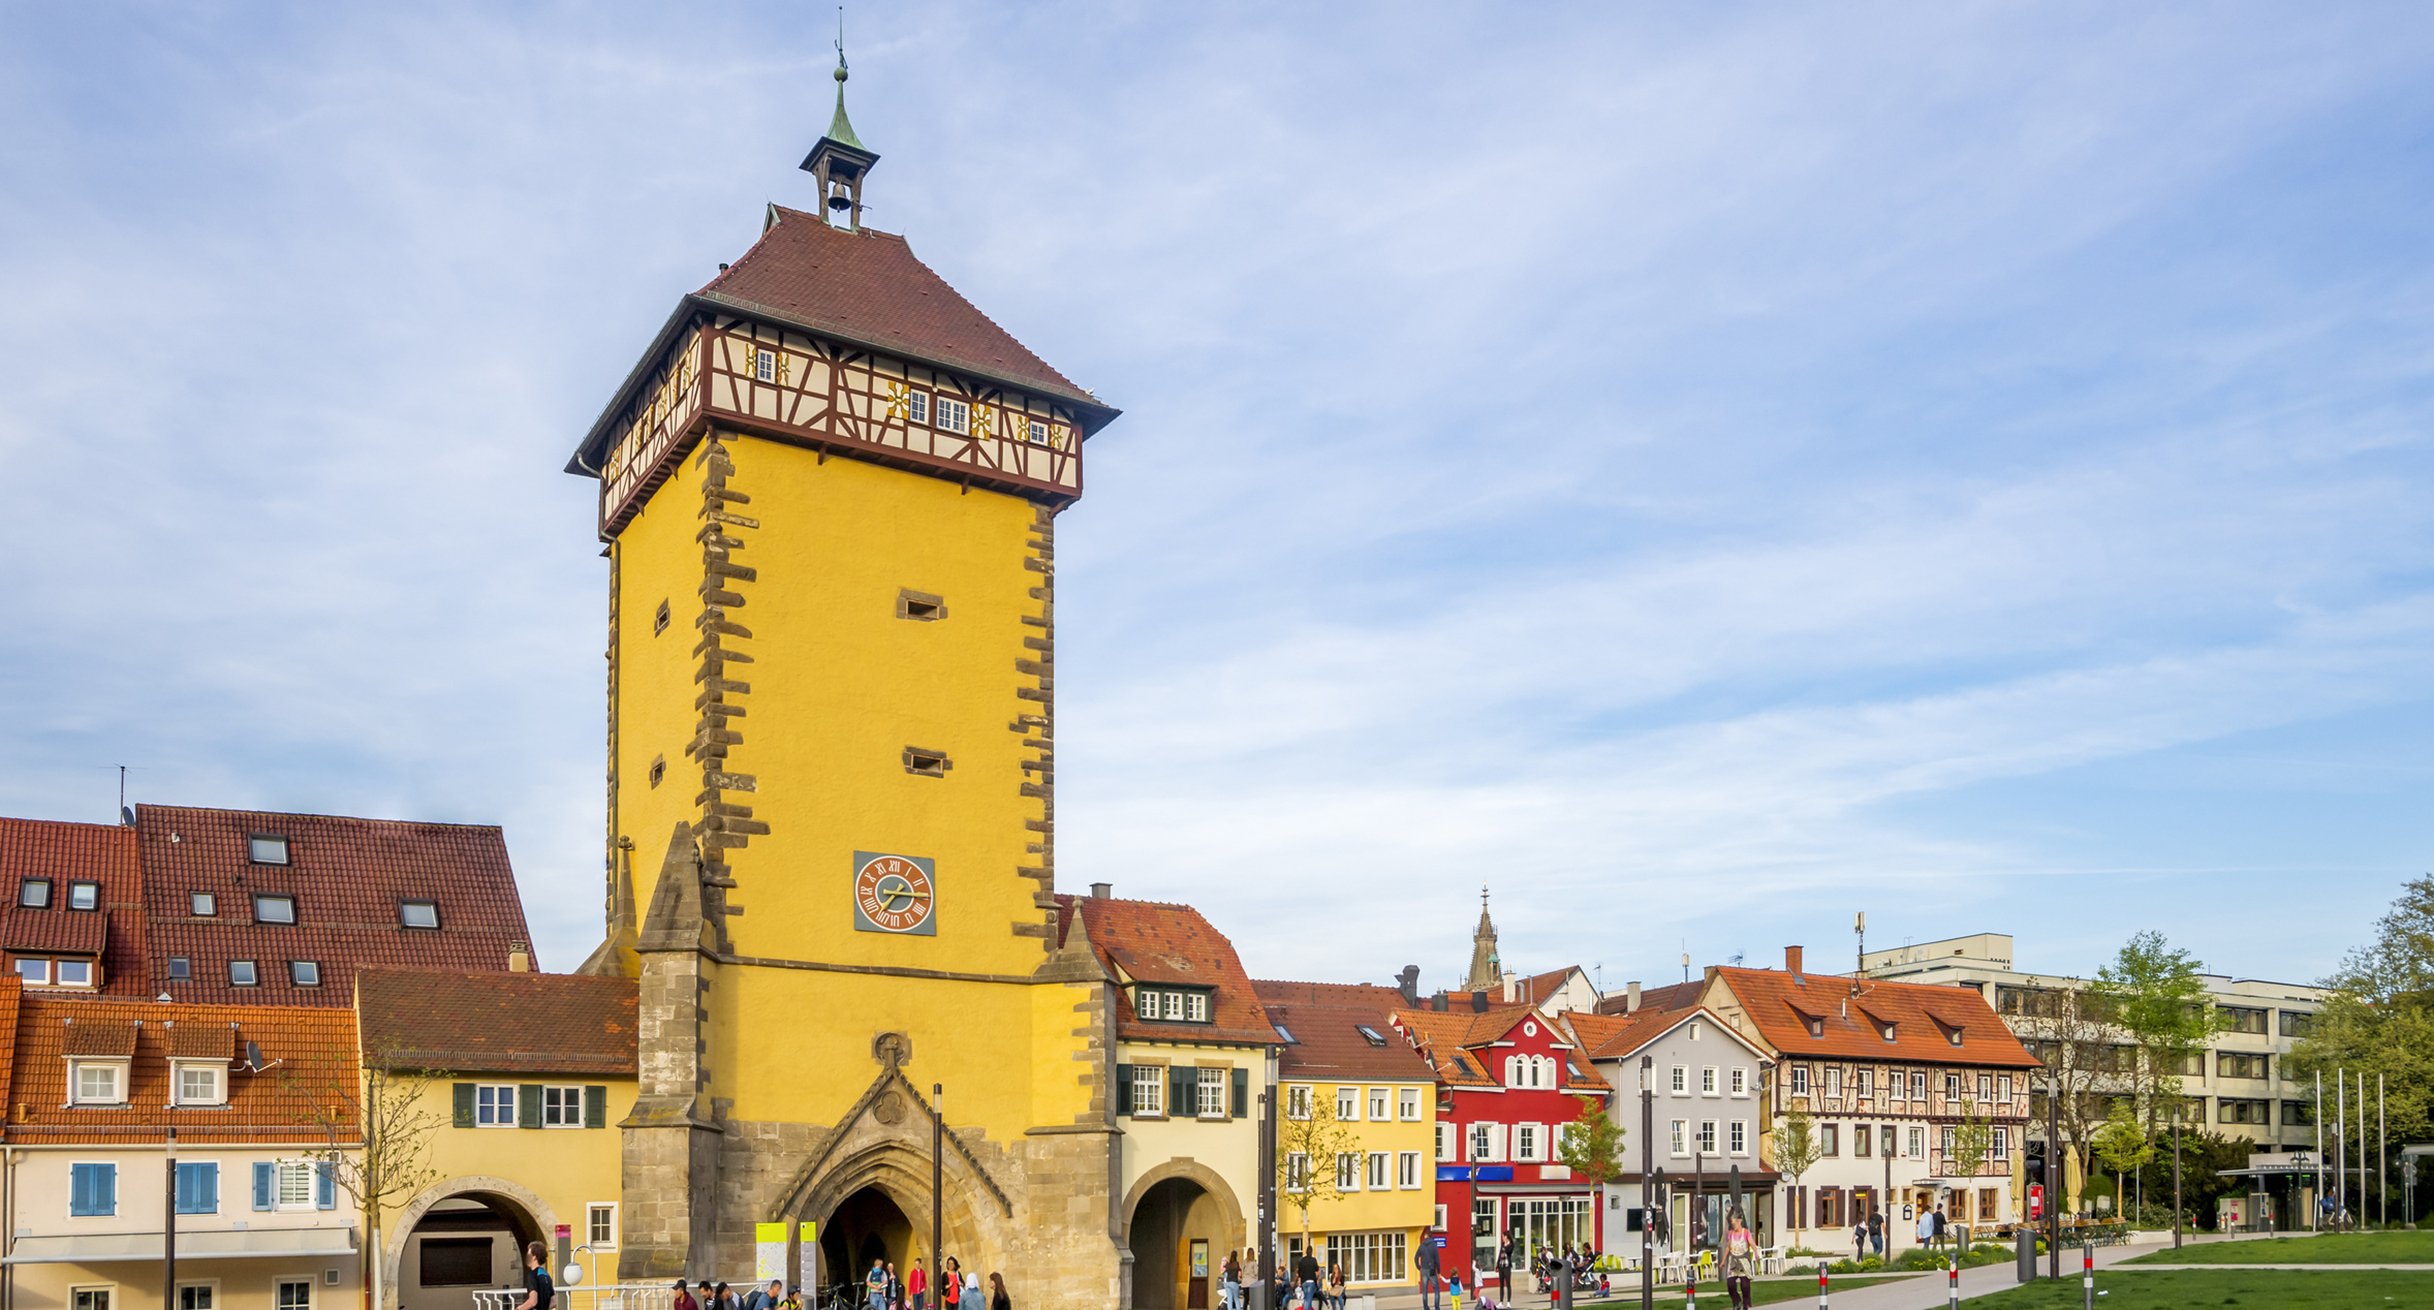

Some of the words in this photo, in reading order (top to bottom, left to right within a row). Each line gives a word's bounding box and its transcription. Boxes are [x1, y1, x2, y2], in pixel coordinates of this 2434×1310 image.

[875, 862, 887, 875] XI
[888, 860, 900, 873] XII
[864, 872, 876, 883] X
[913, 878, 925, 887] II
[860, 886, 873, 895] IX
